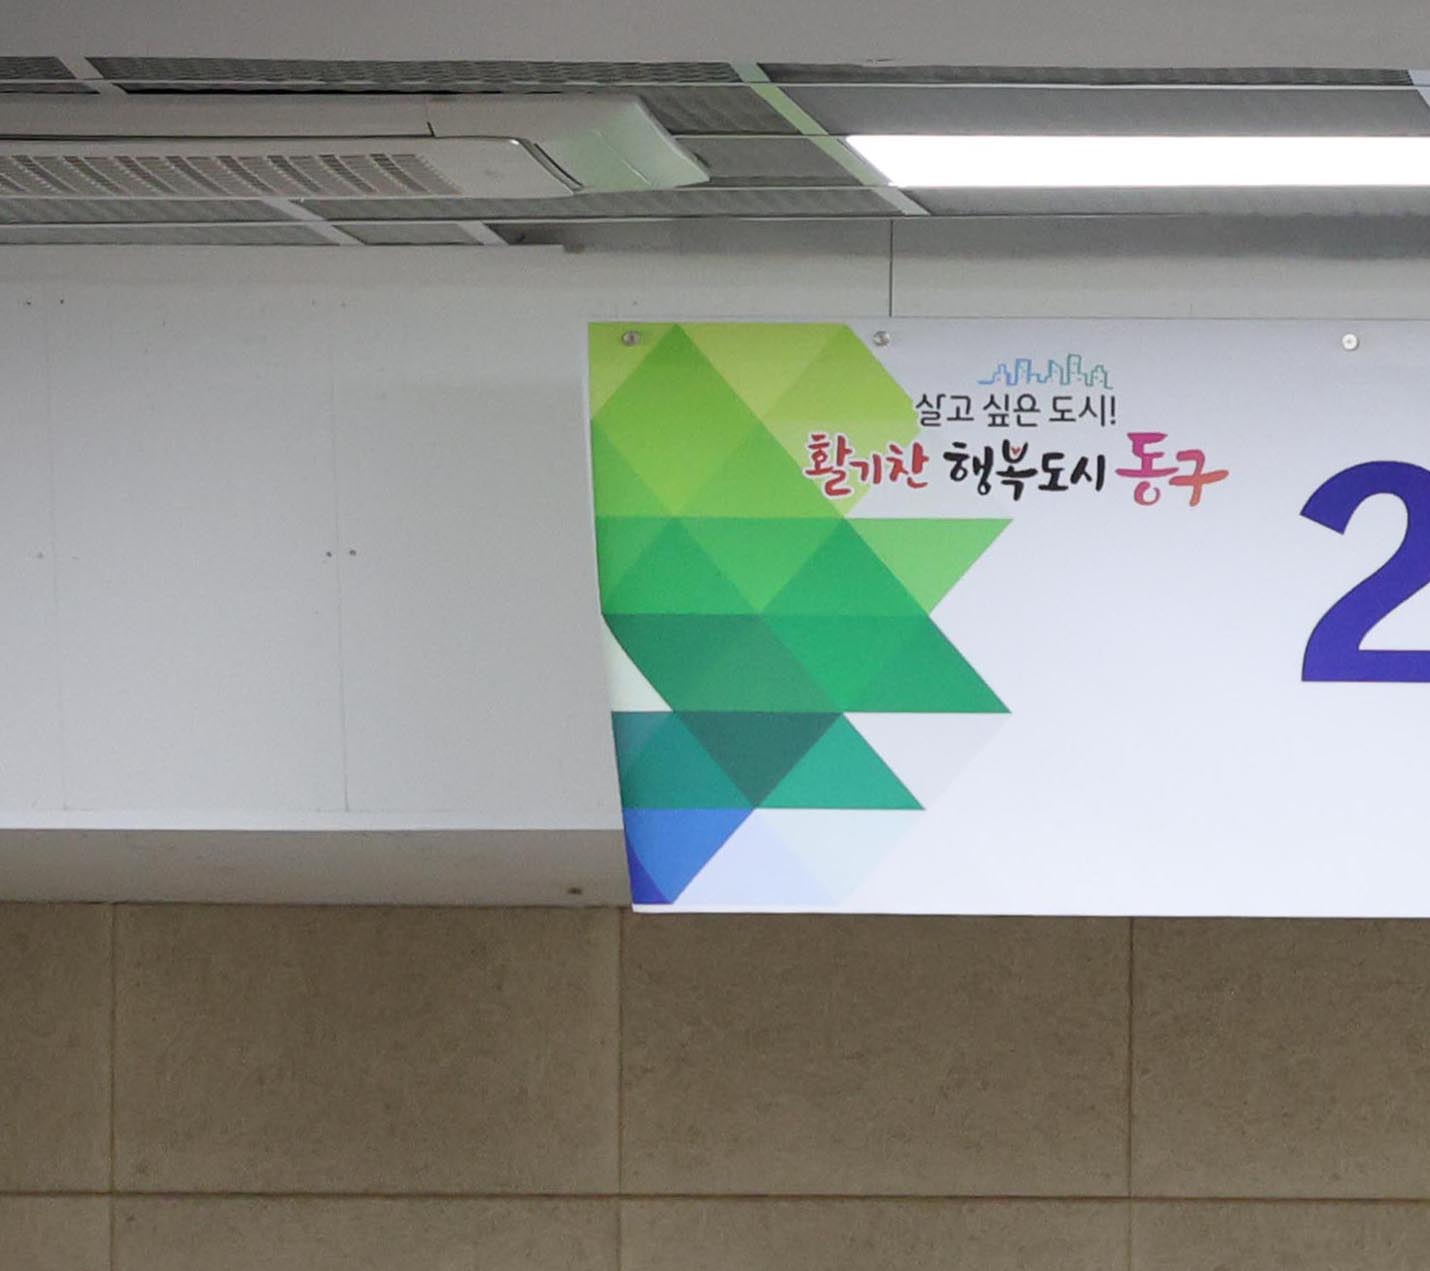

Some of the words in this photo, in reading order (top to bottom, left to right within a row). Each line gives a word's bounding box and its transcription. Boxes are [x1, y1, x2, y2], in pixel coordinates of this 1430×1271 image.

[914, 393, 975, 428] 살고
[982, 393, 1041, 428] 싶은
[1048, 394, 1117, 428] 도시!
[805, 432, 930, 497] 활기찬
[942, 438, 1107, 501] 행복도시
[1115, 431, 1229, 507] 동구
